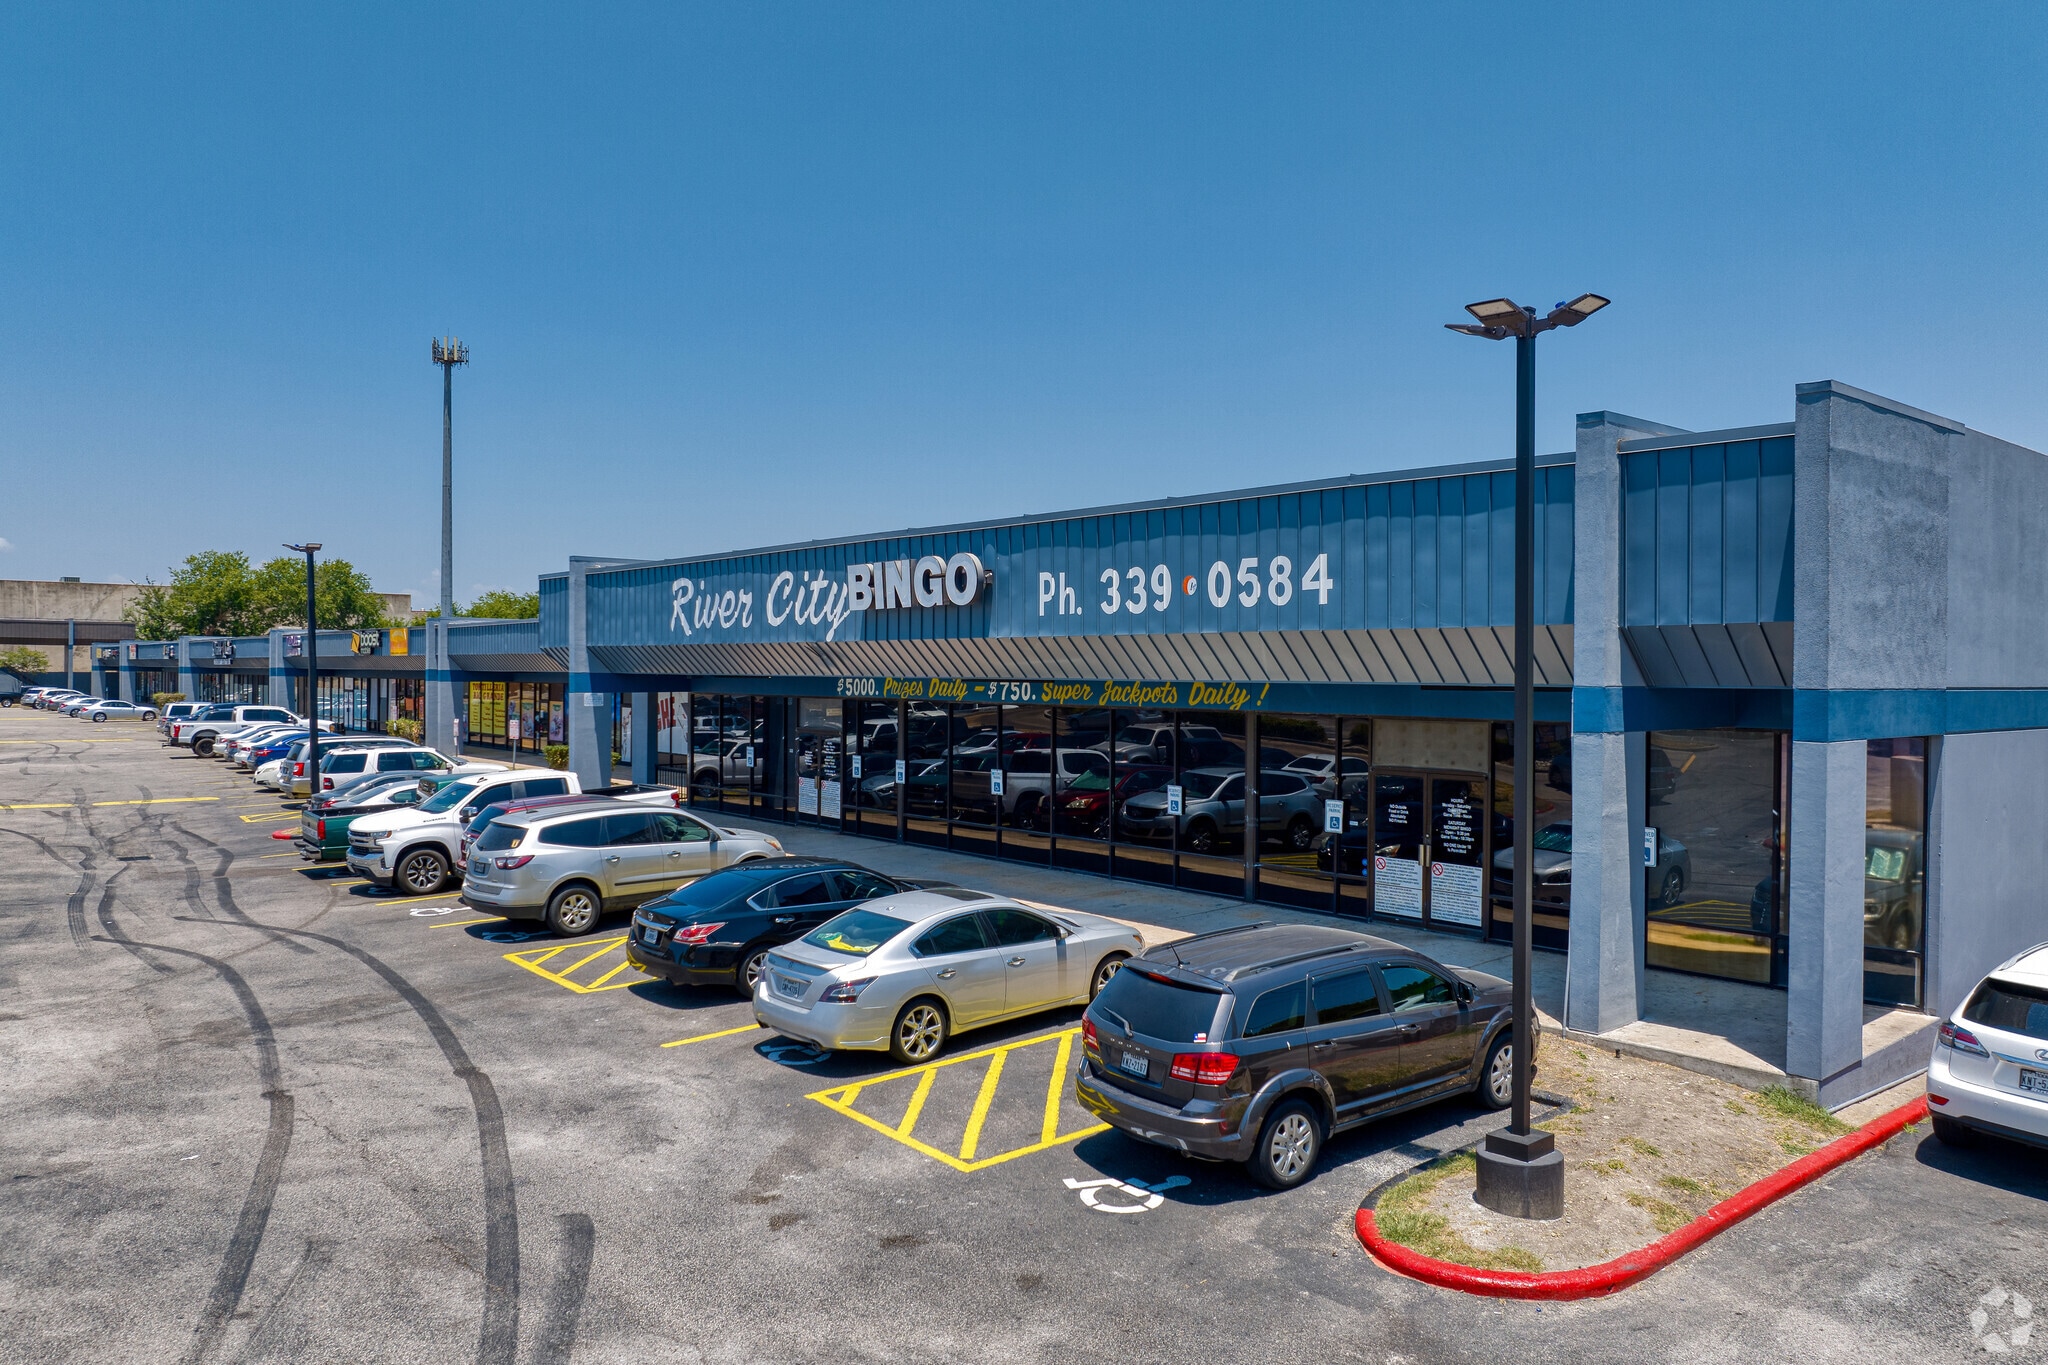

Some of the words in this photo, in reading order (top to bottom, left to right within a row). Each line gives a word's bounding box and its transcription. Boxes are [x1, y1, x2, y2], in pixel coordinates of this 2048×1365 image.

[670, 577, 752, 636] River
[766, 568, 851, 642] City
[847, 552, 984, 611] BINGO
[1039, 572, 1082, 616] Ph.
[1100, 564, 1172, 614] 339
[1207, 553, 1333, 608] 0584
[360, 630, 380, 646] boost
[837, 678, 879, 696] $5000.
[883, 677, 923, 698] Prizes
[928, 677, 968, 701] Daily
[988, 681, 1036, 701] $750.
[1041, 682, 1093, 704] Super
[1099, 680, 1177, 707] Jackpots
[2021, 1076, 2048, 1089] KNT-5
